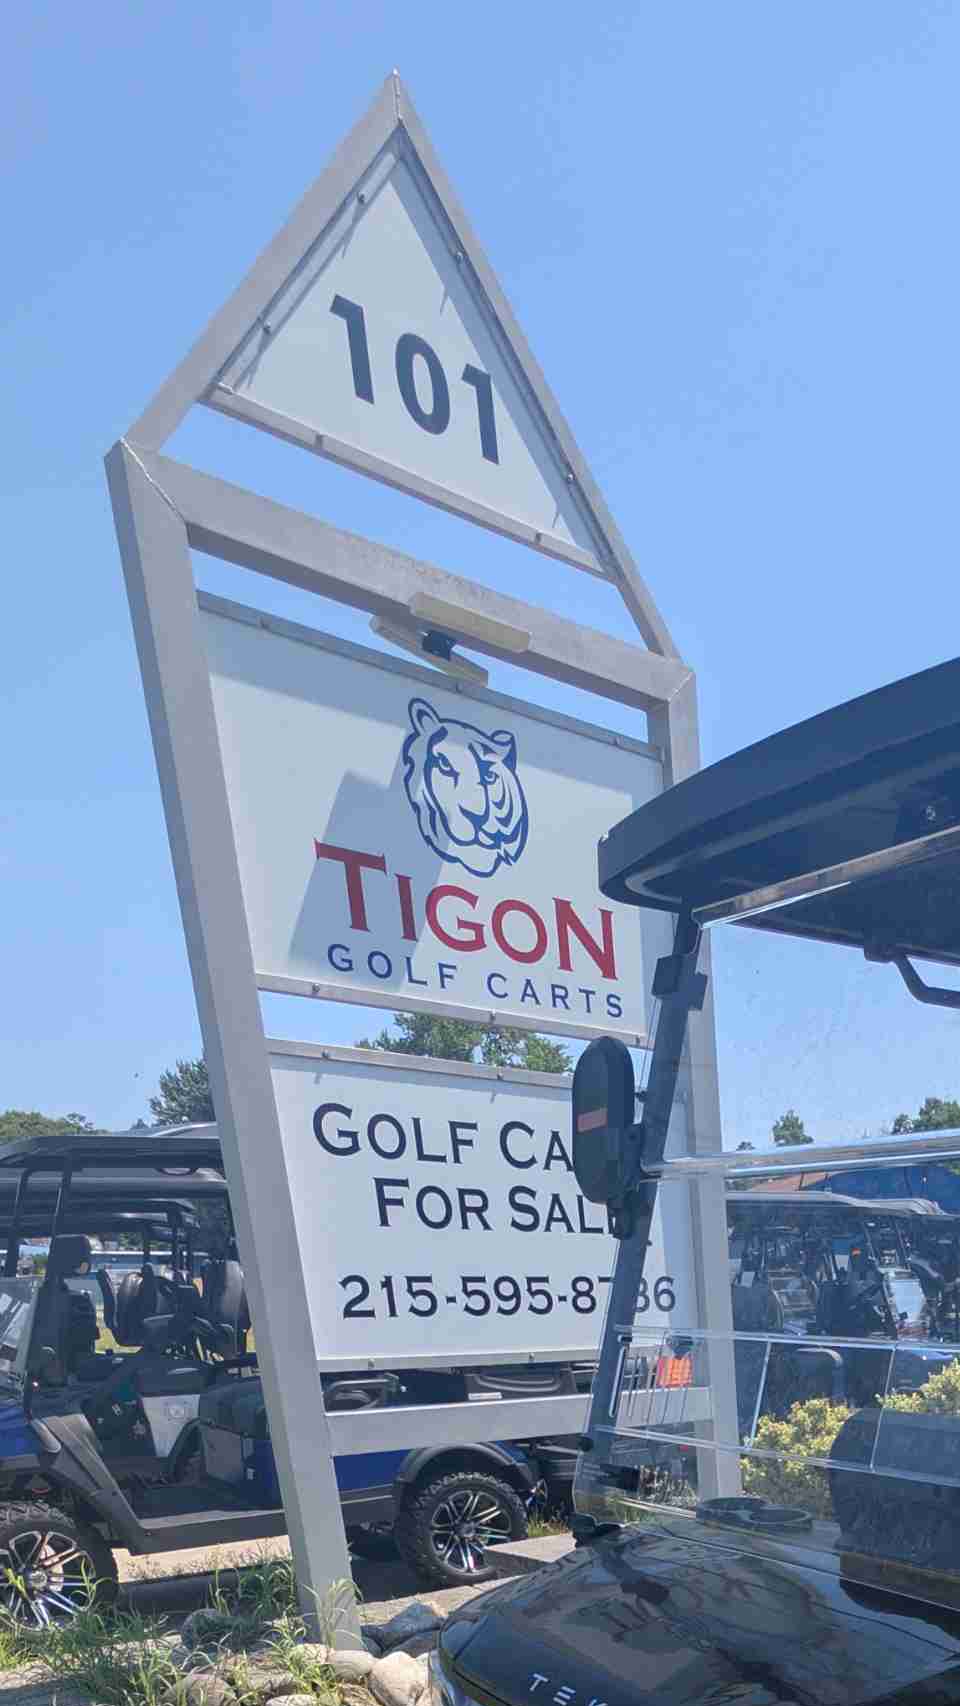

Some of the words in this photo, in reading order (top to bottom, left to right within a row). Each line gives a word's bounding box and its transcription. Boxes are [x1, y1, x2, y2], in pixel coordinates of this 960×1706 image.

[329, 293, 500, 466] 101
[313, 838, 618, 981] TIGON
[327, 943, 457, 989] GOLF
[486, 972, 623, 1018] CARTS
[312, 1102, 479, 1165] GOLF
[372, 1176, 493, 1232] FOR
[507, 1184, 617, 1236] SAL
